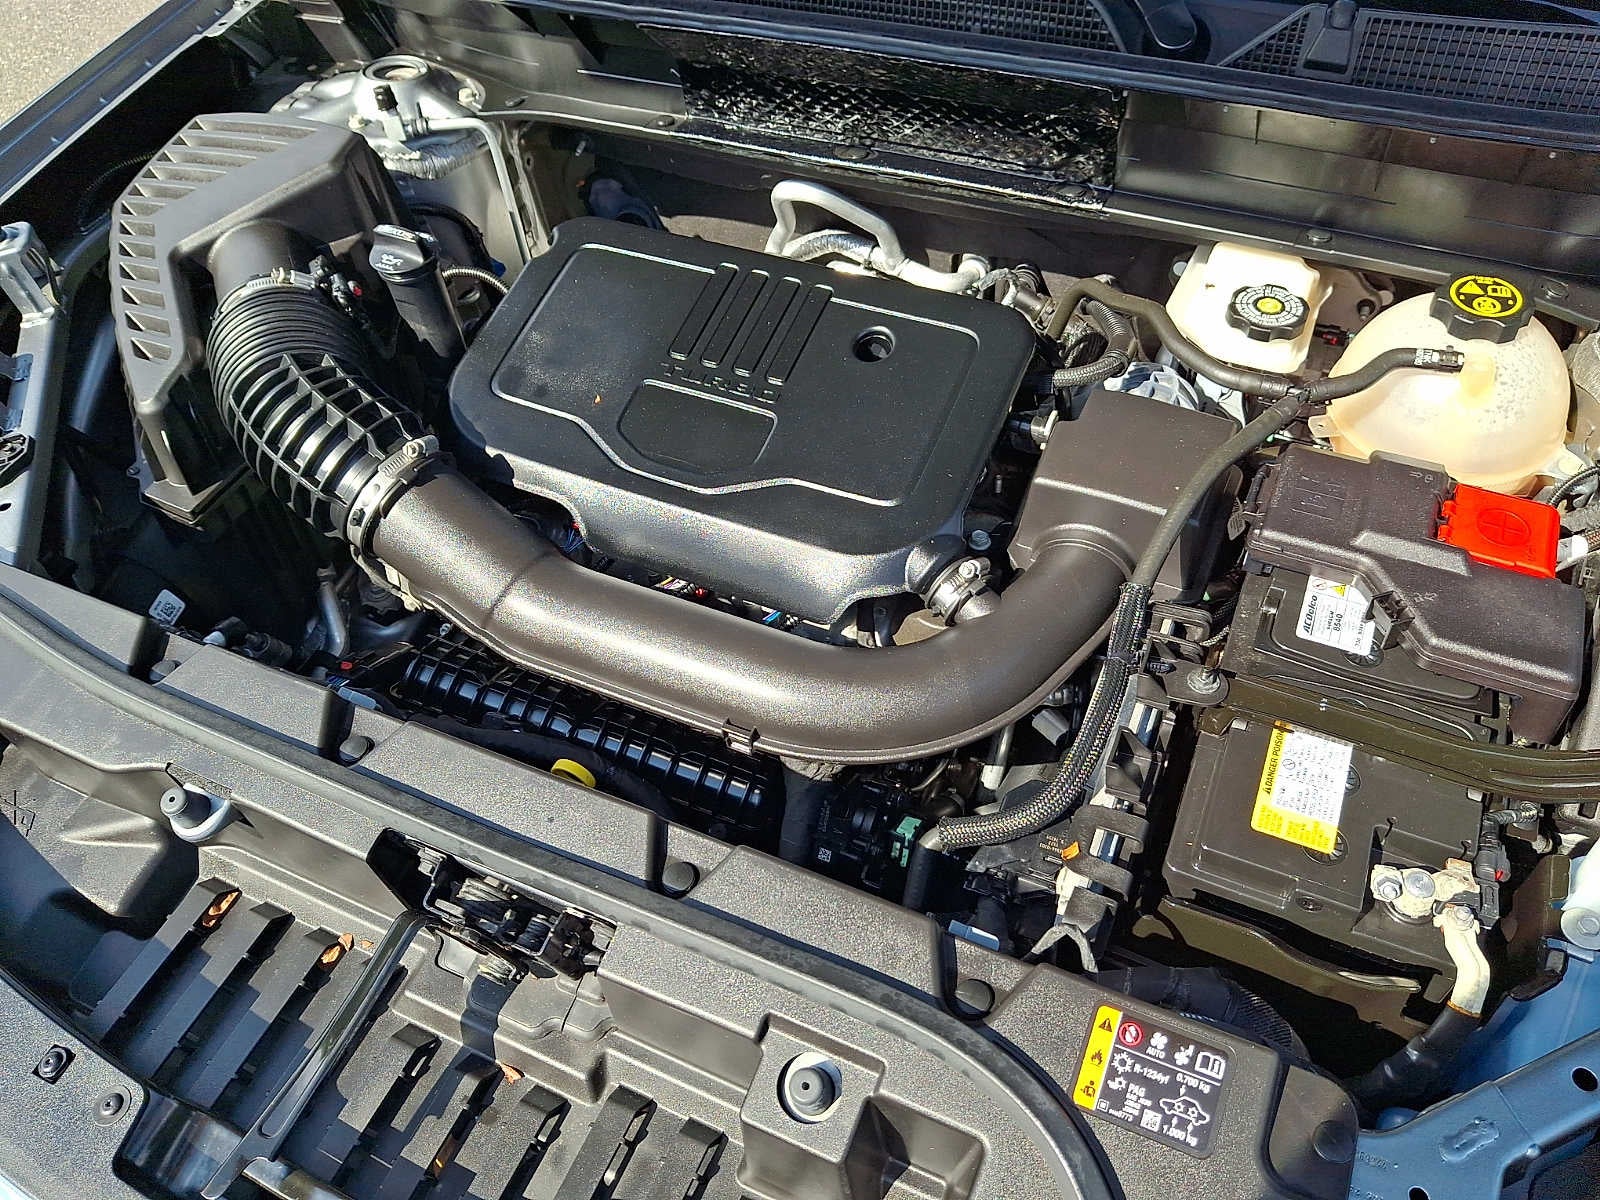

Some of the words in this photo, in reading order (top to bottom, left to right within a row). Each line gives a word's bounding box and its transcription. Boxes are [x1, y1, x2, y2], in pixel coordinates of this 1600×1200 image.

[659, 361, 781, 404] TURBO
[1303, 595, 1318, 633] ACDelco
[1265, 757, 1279, 787] DANGER
[1146, 1046, 1166, 1059] AUTO
[1134, 1064, 1170, 1085] R-1234yf
[1176, 1072, 1199, 1088] 0.700
[1199, 1078, 1211, 1094] kg
[1186, 1133, 1199, 1147] kg
